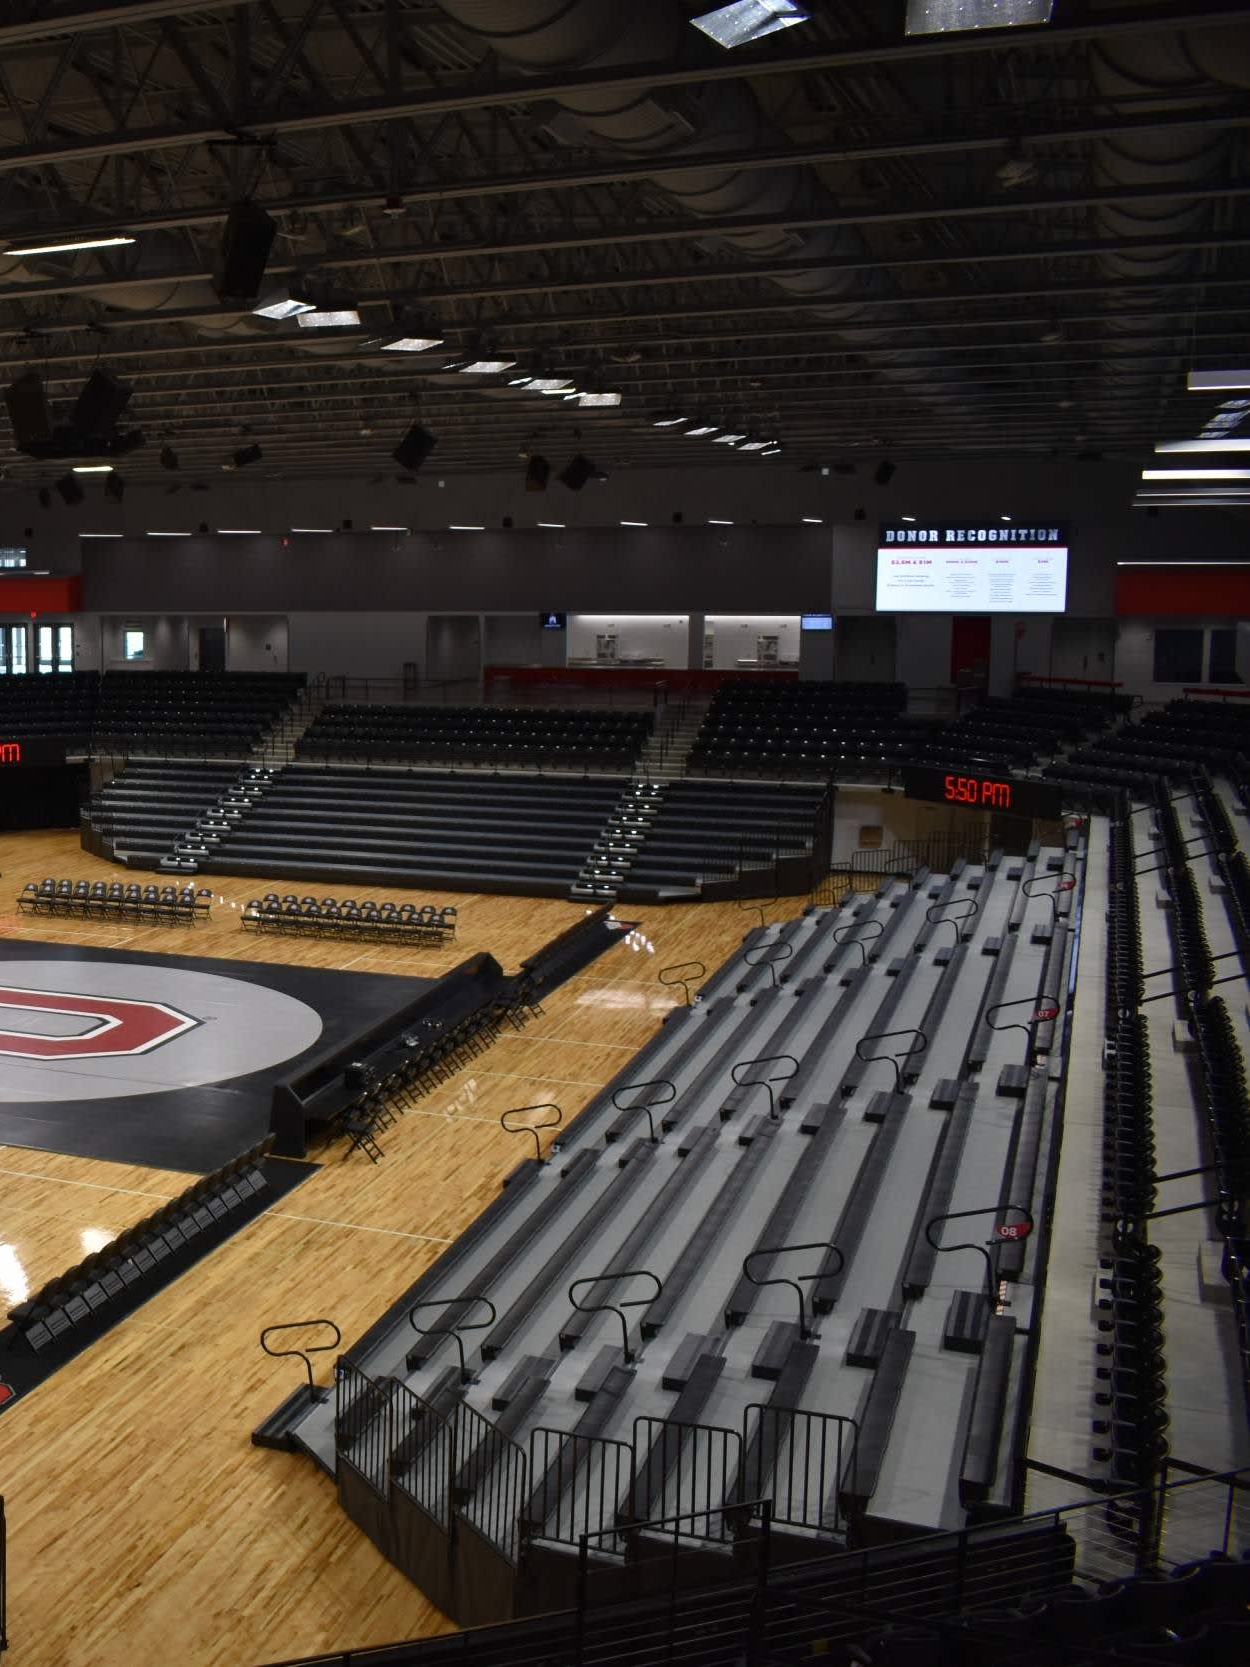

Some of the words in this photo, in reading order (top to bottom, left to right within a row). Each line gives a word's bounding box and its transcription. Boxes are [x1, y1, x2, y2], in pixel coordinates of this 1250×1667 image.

[886, 530, 939, 542] DONOR
[945, 529, 1059, 542] RECOGNITION
[945, 776, 977, 803] 5:50
[982, 781, 1011, 809] PM
[1001, 1226, 1017, 1237] 08
